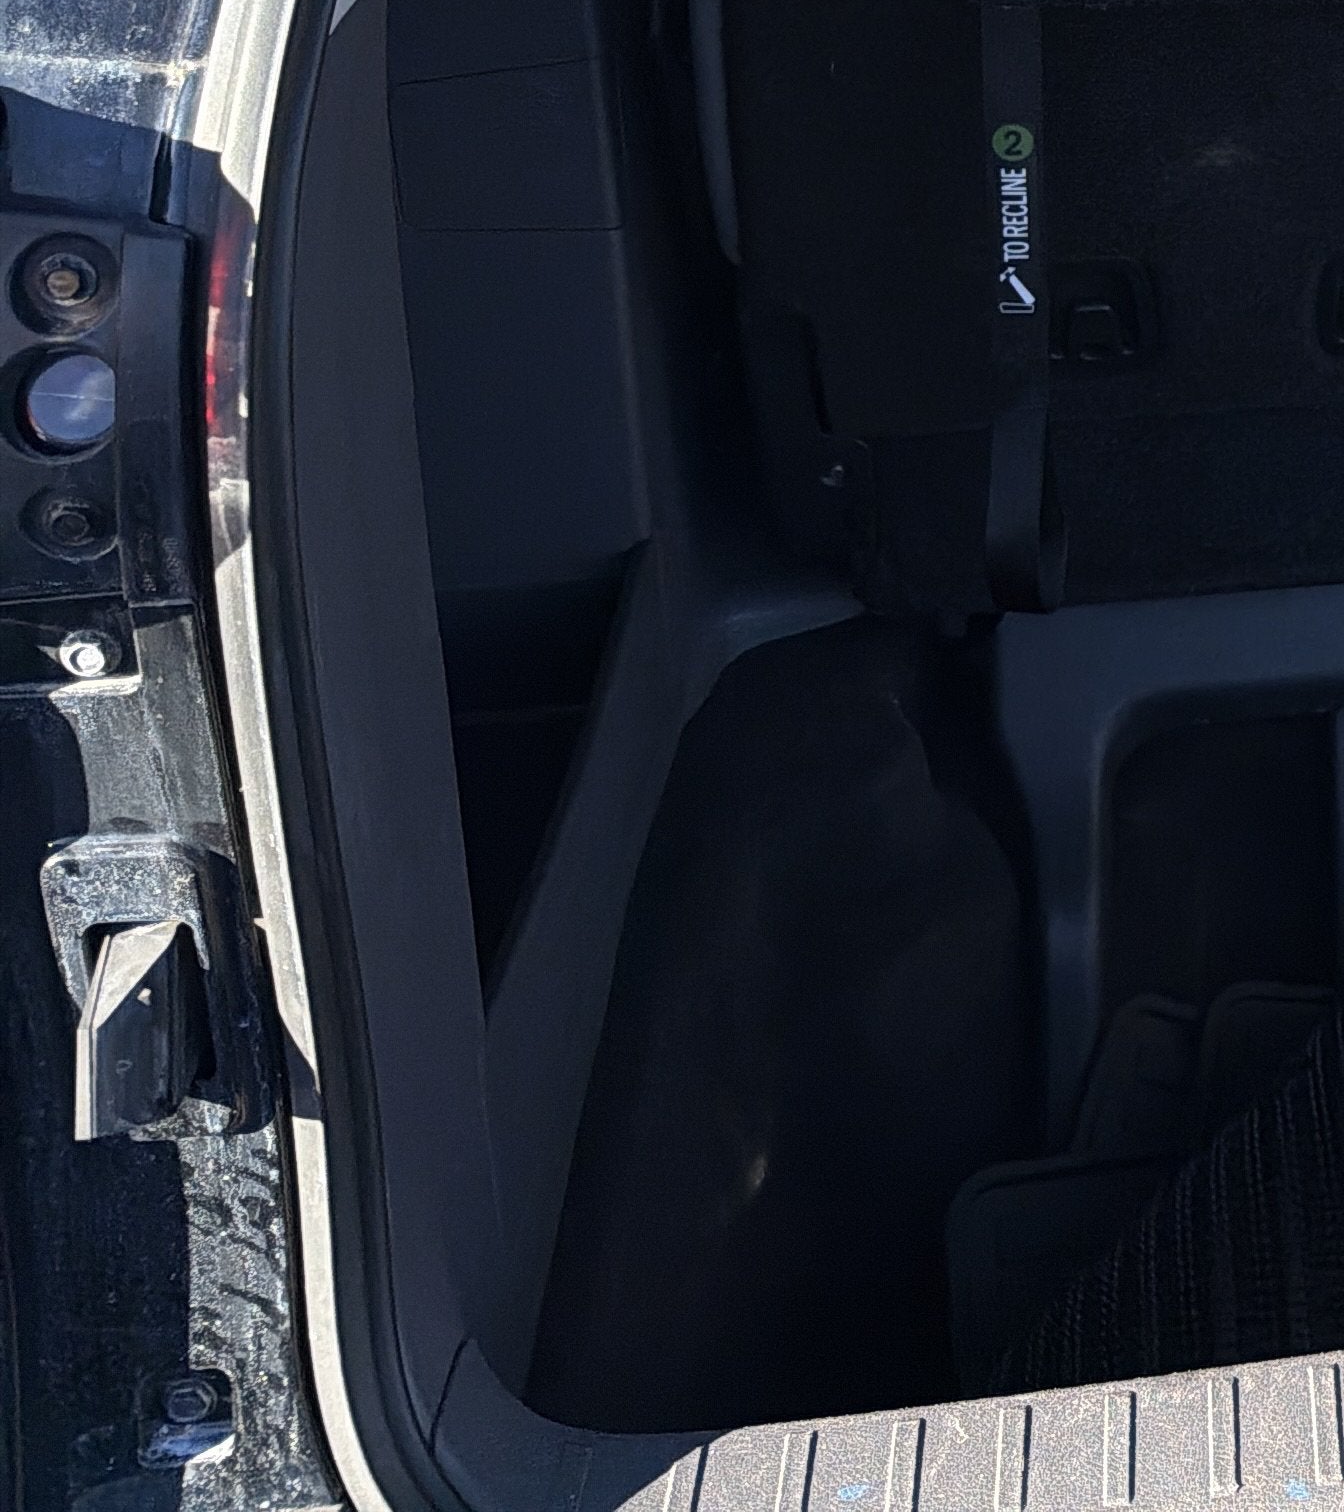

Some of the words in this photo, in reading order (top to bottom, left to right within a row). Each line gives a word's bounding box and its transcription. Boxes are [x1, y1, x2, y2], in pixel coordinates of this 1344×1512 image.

[1003, 129, 1023, 157] 2
[1000, 167, 1029, 238] RECLINE
[1003, 240, 1030, 263] TO
